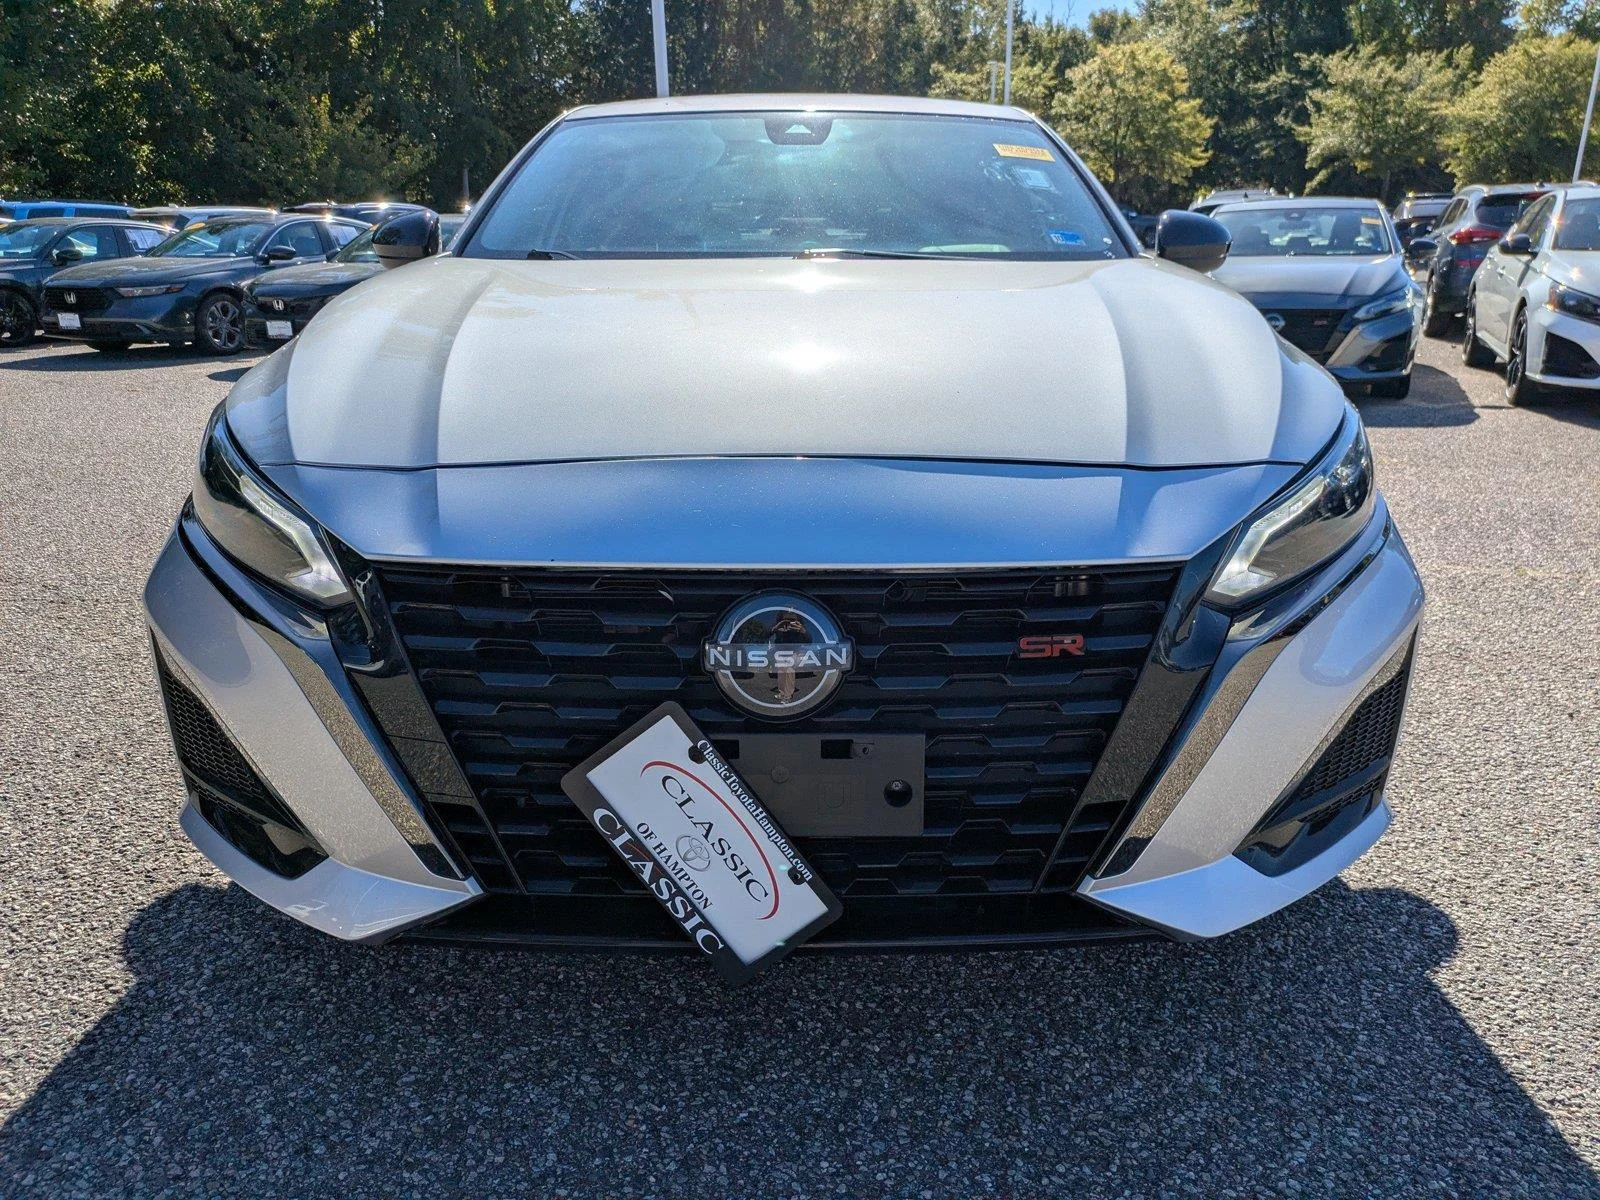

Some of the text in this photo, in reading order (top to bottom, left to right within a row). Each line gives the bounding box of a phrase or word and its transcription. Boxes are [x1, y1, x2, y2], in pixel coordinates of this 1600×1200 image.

[709, 646, 848, 669] NISSAN
[1018, 633, 1085, 659] SR
[661, 774, 769, 903] CLASSIC
[696, 739, 813, 882] ClassicToyotaHampton.com
[593, 807, 724, 955] CLASSIC
[636, 821, 713, 910] OF HAMPTON
